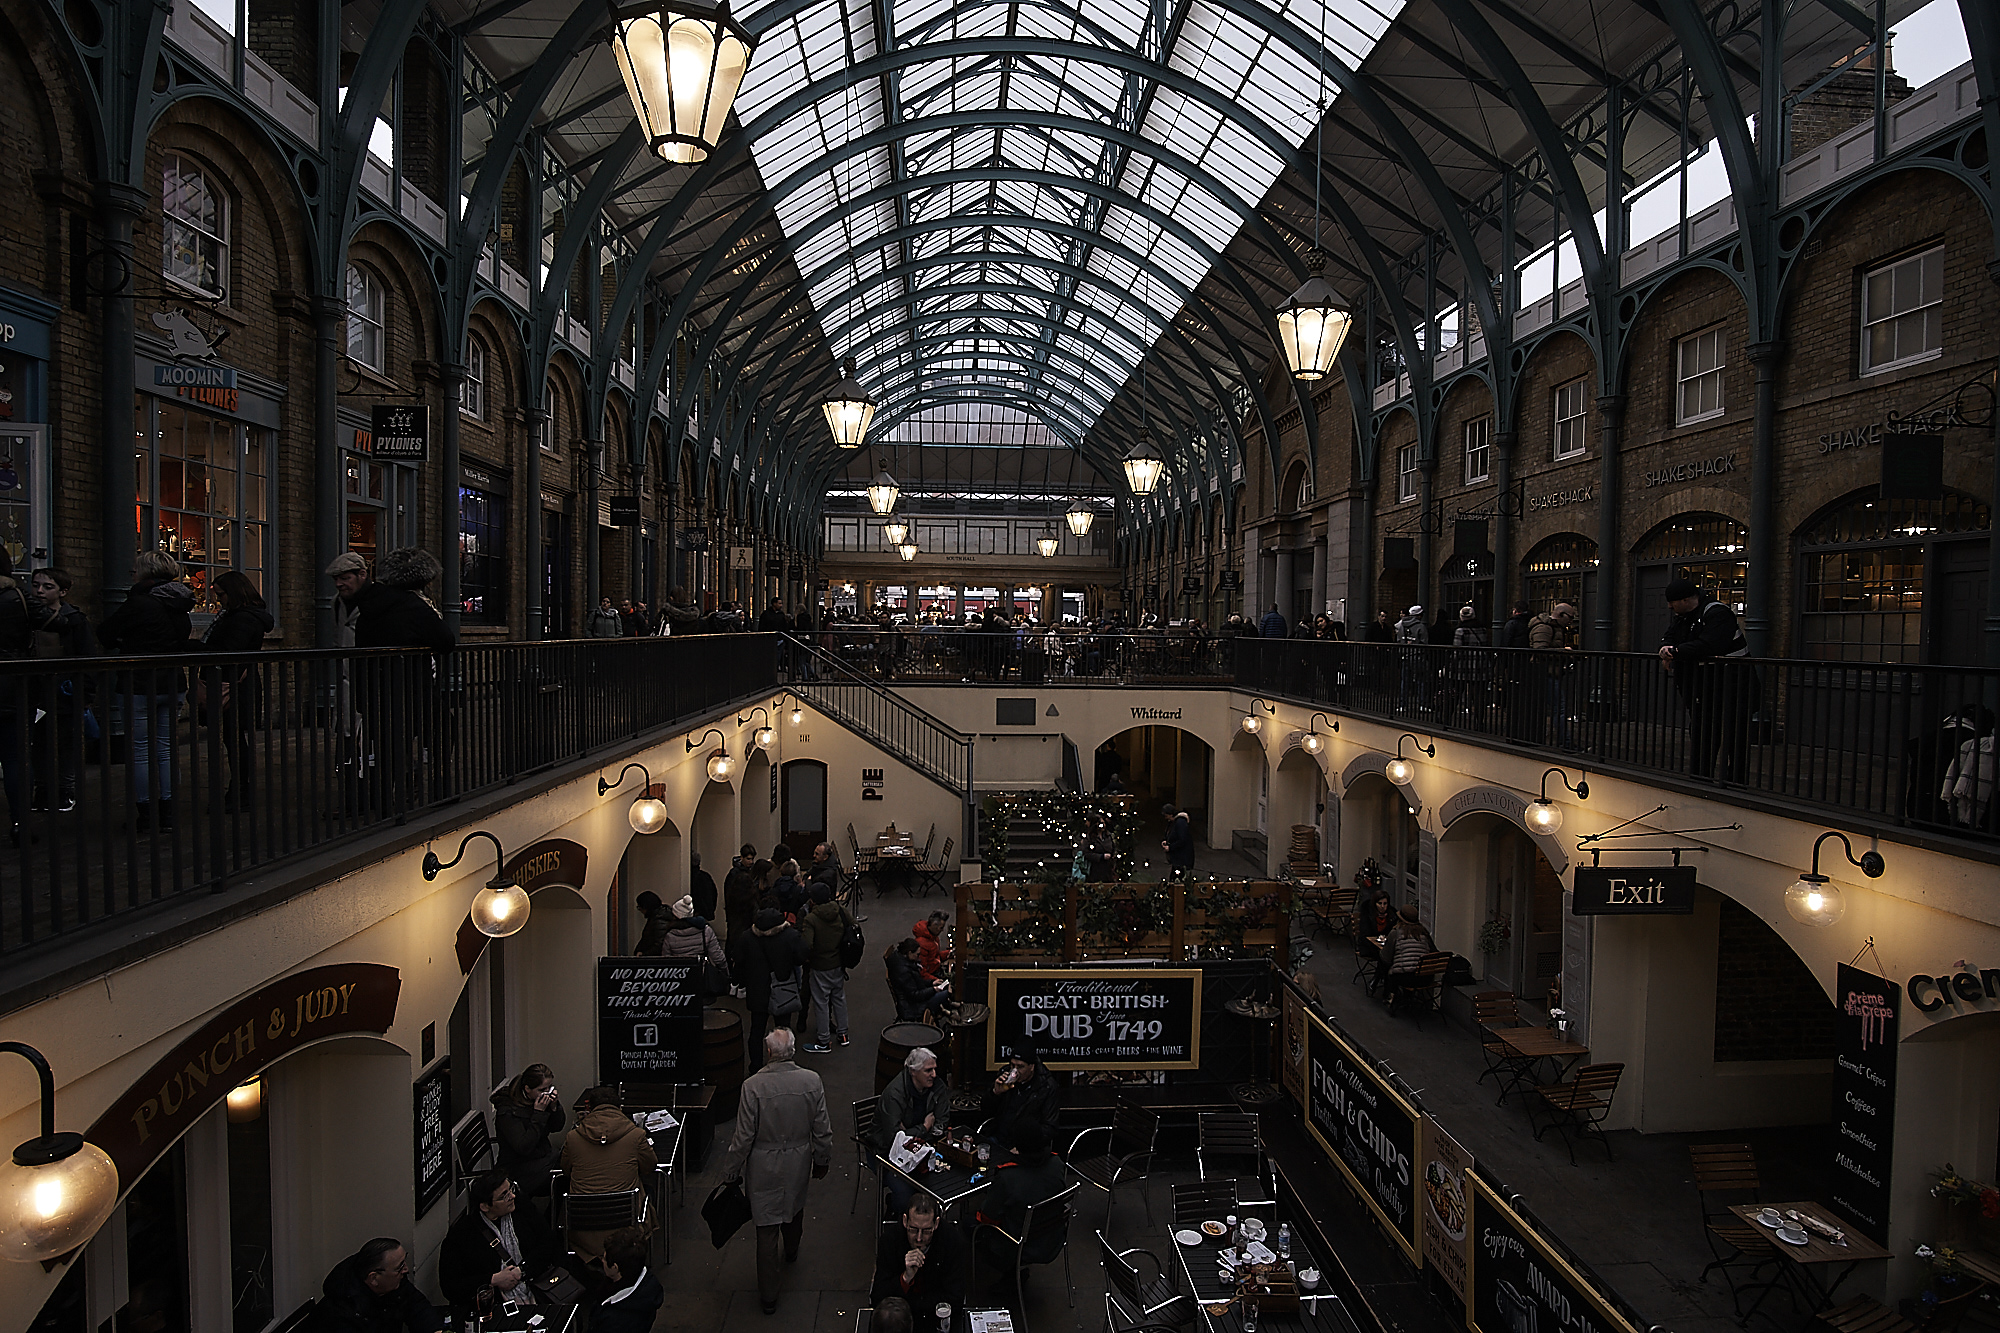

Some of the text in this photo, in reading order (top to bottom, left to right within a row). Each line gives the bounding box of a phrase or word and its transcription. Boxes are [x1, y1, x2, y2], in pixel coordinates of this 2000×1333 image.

[161, 367, 224, 385] MOOMIN
[376, 437, 423, 450] PYLONES
[1818, 422, 1882, 454] SHAKE
[1645, 453, 1735, 489] SHAKE SHACK
[1529, 486, 1593, 512] SHAKE SHACK
[1130, 707, 1182, 719] Whittard
[1454, 792, 1523, 820] CHEZ ANTOINE
[512, 850, 561, 886] HISKIES
[1606, 878, 1666, 905] Exit
[610, 967, 690, 980] NO DRINKS
[607, 993, 696, 1007] THIS POINT
[620, 981, 681, 993] BEYOND
[1055, 980, 1140, 994] Traditional
[622, 1009, 673, 1021] Thank You
[1017, 994, 1169, 1010] GREAT BRITISH
[1024, 1012, 1094, 1039] PUB
[1095, 1010, 1126, 1023] Since
[1105, 1020, 1163, 1041] 1749
[1053, 1047, 1068, 1055] REAL
[1069, 1045, 1091, 1056] ALES
[1094, 1047, 1115, 1055] CRAFT
[1116, 1045, 1140, 1056] BEERS
[1146, 1046, 1160, 1054] FINE
[1162, 1045, 1184, 1056] WINE
[131, 982, 358, 1146] PUNCH & JUDY
[649, 1059, 676, 1070] GARDEN
[1838, 1054, 1866, 1075] Gourmet
[422, 1081, 442, 1107] PUNCH
[1335, 1059, 1378, 1110] Our Ultimate
[426, 1093, 441, 1117] JUDY
[1845, 1090, 1876, 1116] Coffees
[424, 1109, 439, 1133] FREE
[1313, 1057, 1410, 1186] FISH & CHIPS
[1841, 1121, 1877, 1151] Smoothies
[422, 1150, 442, 1182] HERE
[1836, 1152, 1881, 1188] Milkshakes
[1375, 1166, 1408, 1224] Quality
[1426, 1219, 1467, 1277] FISH & CHIPS
[1429, 1242, 1441, 1265] FOR
[1483, 1227, 1525, 1259] Enjoy our
